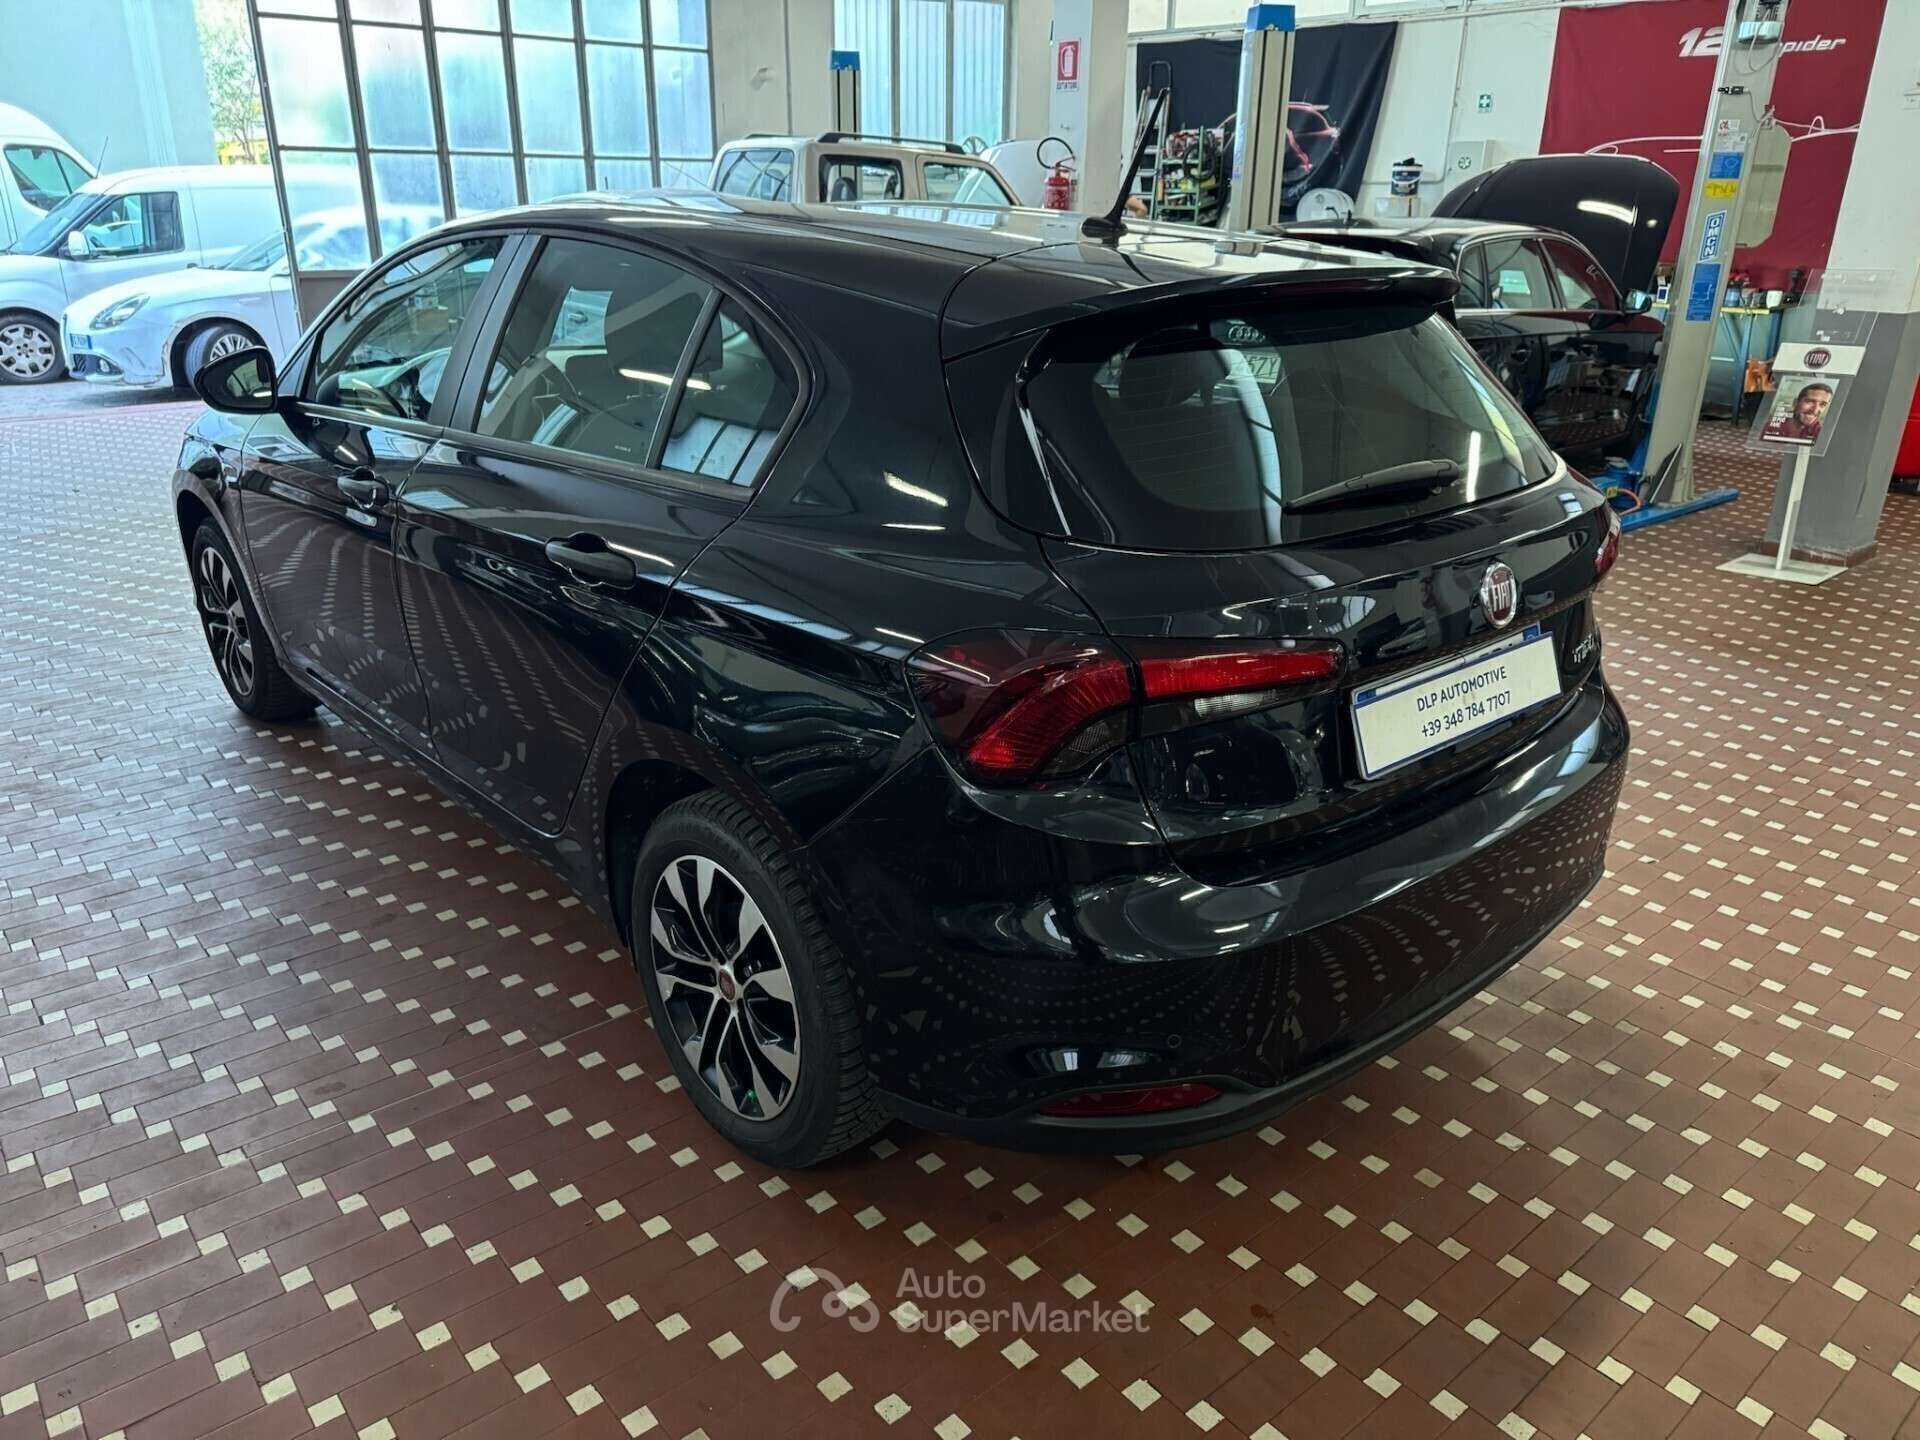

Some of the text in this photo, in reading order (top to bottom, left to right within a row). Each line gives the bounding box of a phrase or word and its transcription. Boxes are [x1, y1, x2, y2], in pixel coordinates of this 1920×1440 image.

[1679, 26, 1846, 58] 12 pider
[1491, 580, 1511, 612] FIAT
[1417, 666, 1507, 711] DLP AUTOMOTIVE
[1422, 691, 1511, 737] +39 348 784 7707
